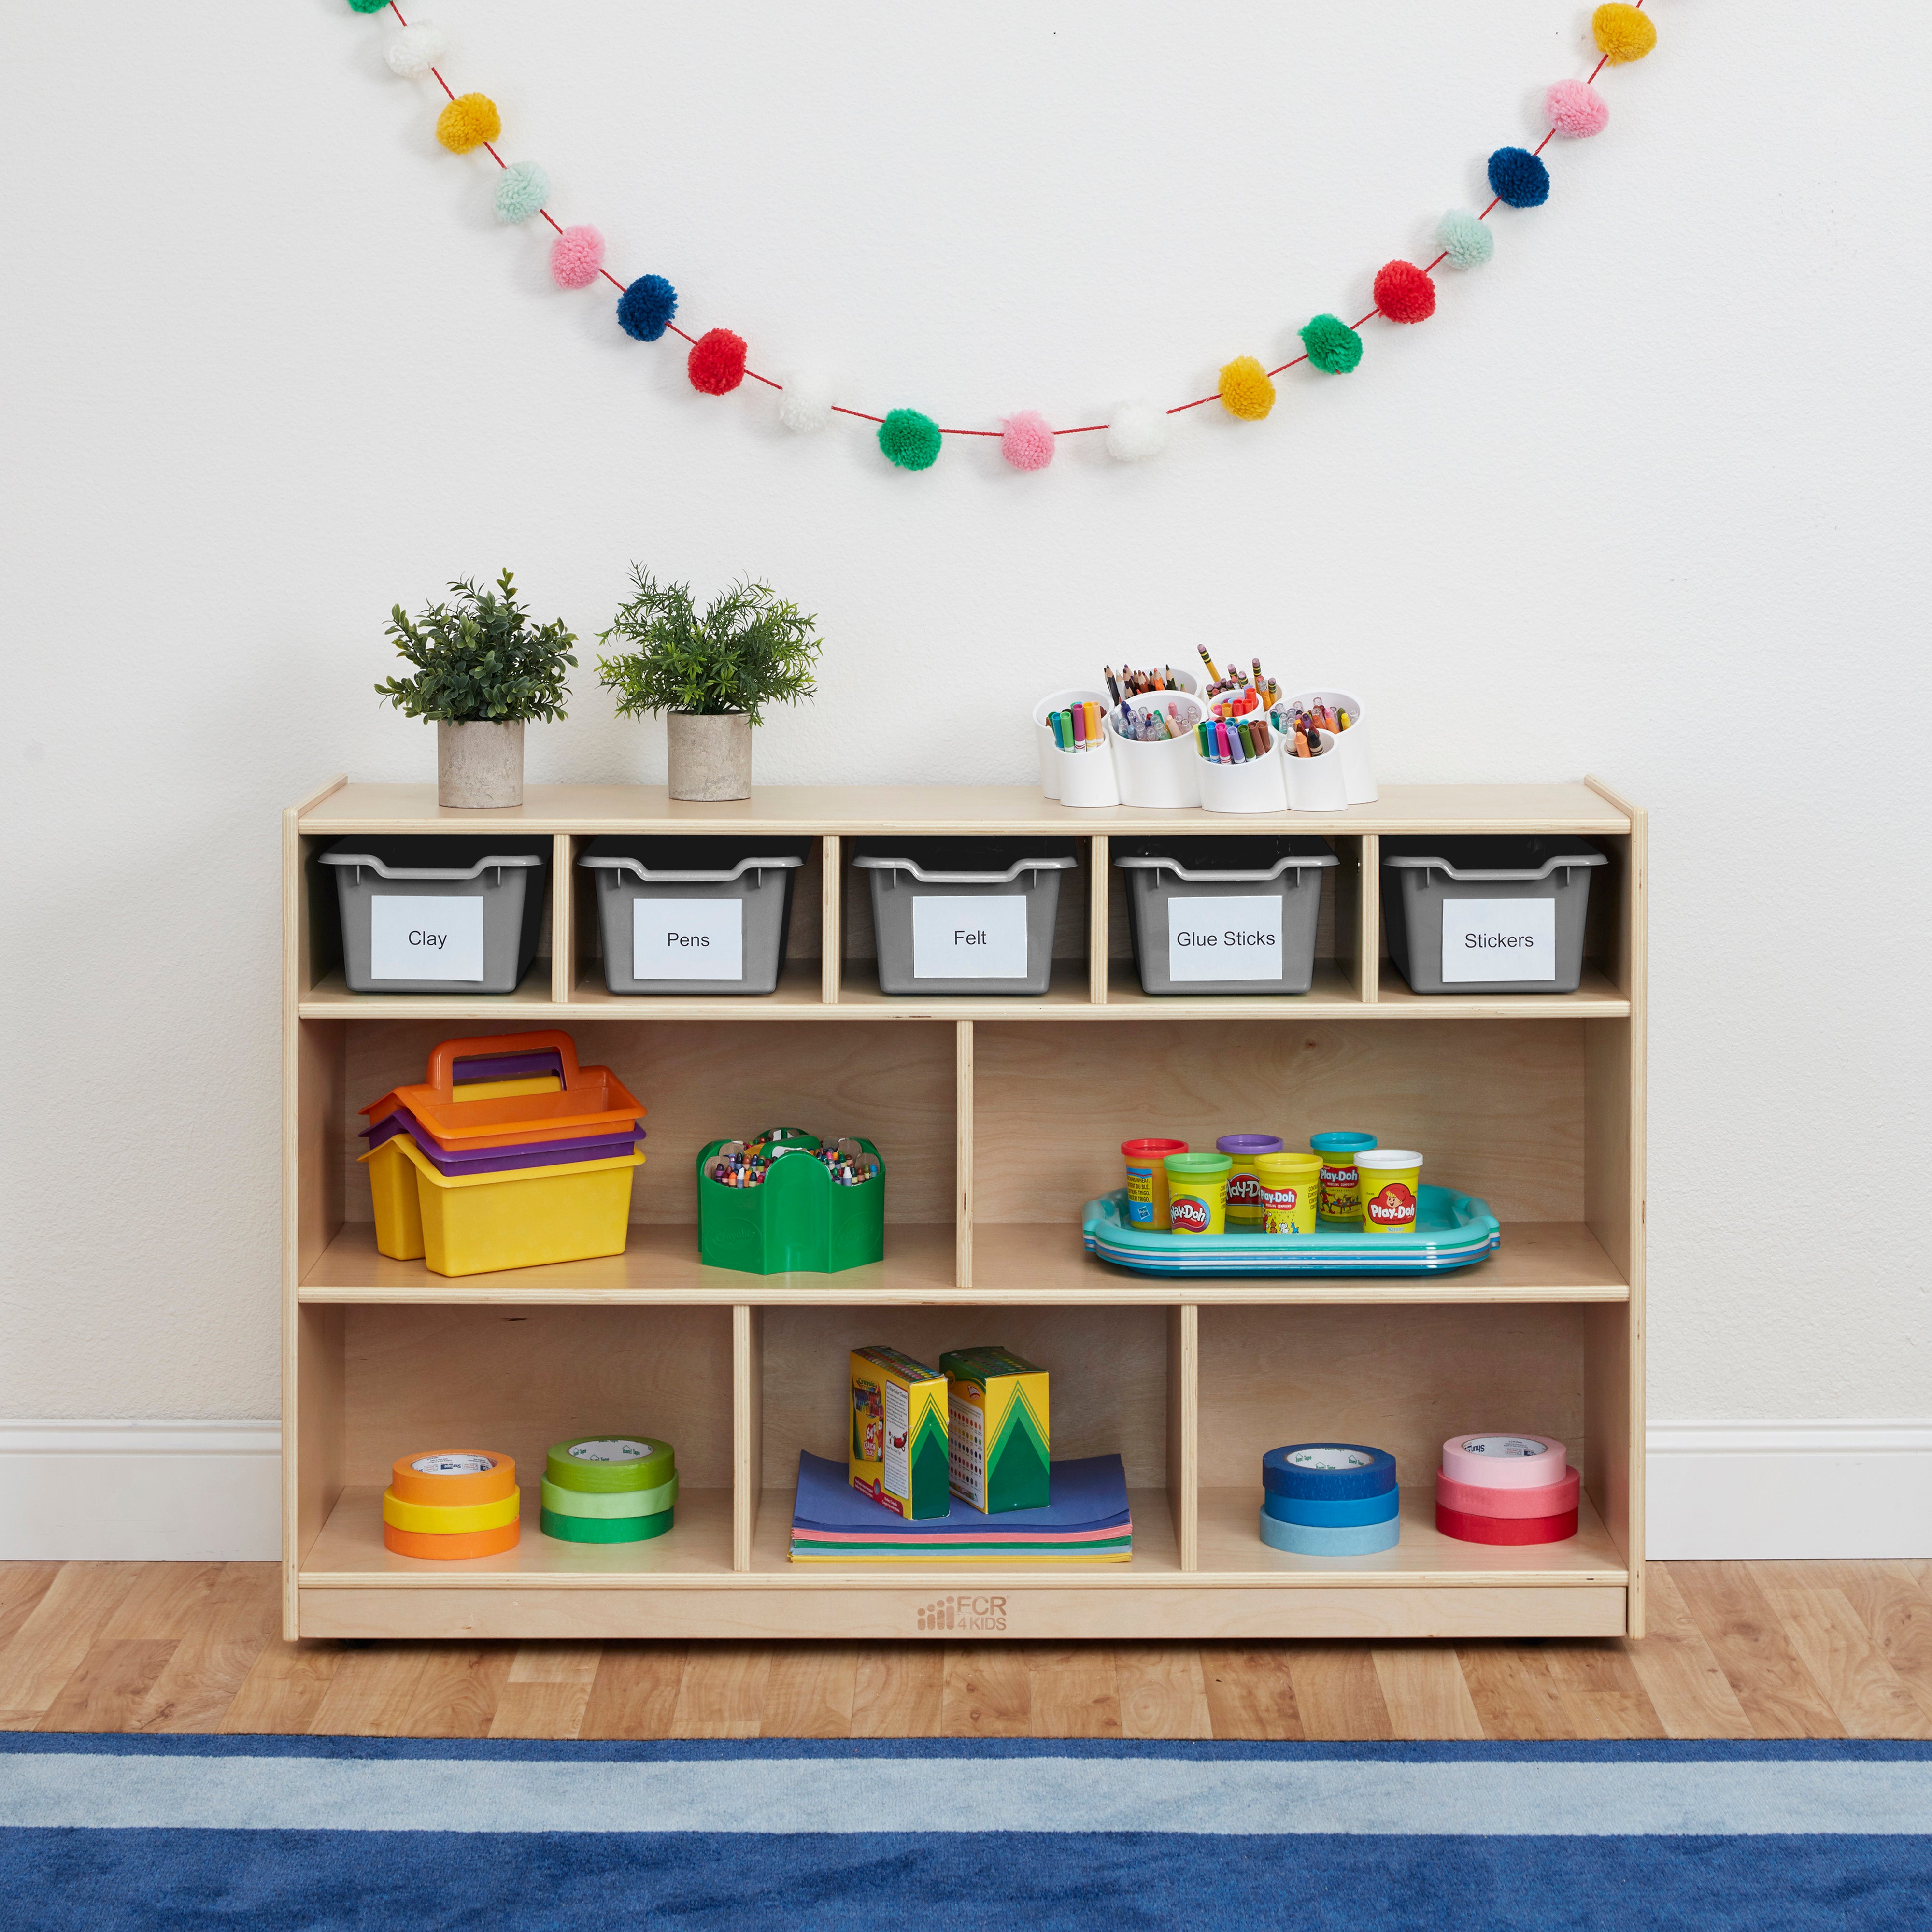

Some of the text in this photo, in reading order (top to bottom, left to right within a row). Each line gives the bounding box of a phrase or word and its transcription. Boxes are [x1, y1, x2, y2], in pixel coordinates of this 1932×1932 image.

[409, 930, 447, 950] Clay
[668, 932, 710, 947] Pens
[954, 930, 987, 945] Felt
[1177, 931, 1275, 947] Glue Sticks
[1465, 933, 1534, 948] Stickers
[1320, 1168, 1358, 1182] Play-Doh
[1226, 1180, 1261, 1200] lay-D
[1260, 1188, 1295, 1204] Play-Doh
[1170, 1204, 1206, 1224] Play-Doh
[1370, 1203, 1415, 1219] Play-Doh
[858, 1378, 876, 1388] Crayola
[867, 1428, 873, 1440] 64
[957, 1595, 1007, 1616] FCR
[957, 1617, 1007, 1631] 4 KIDS
